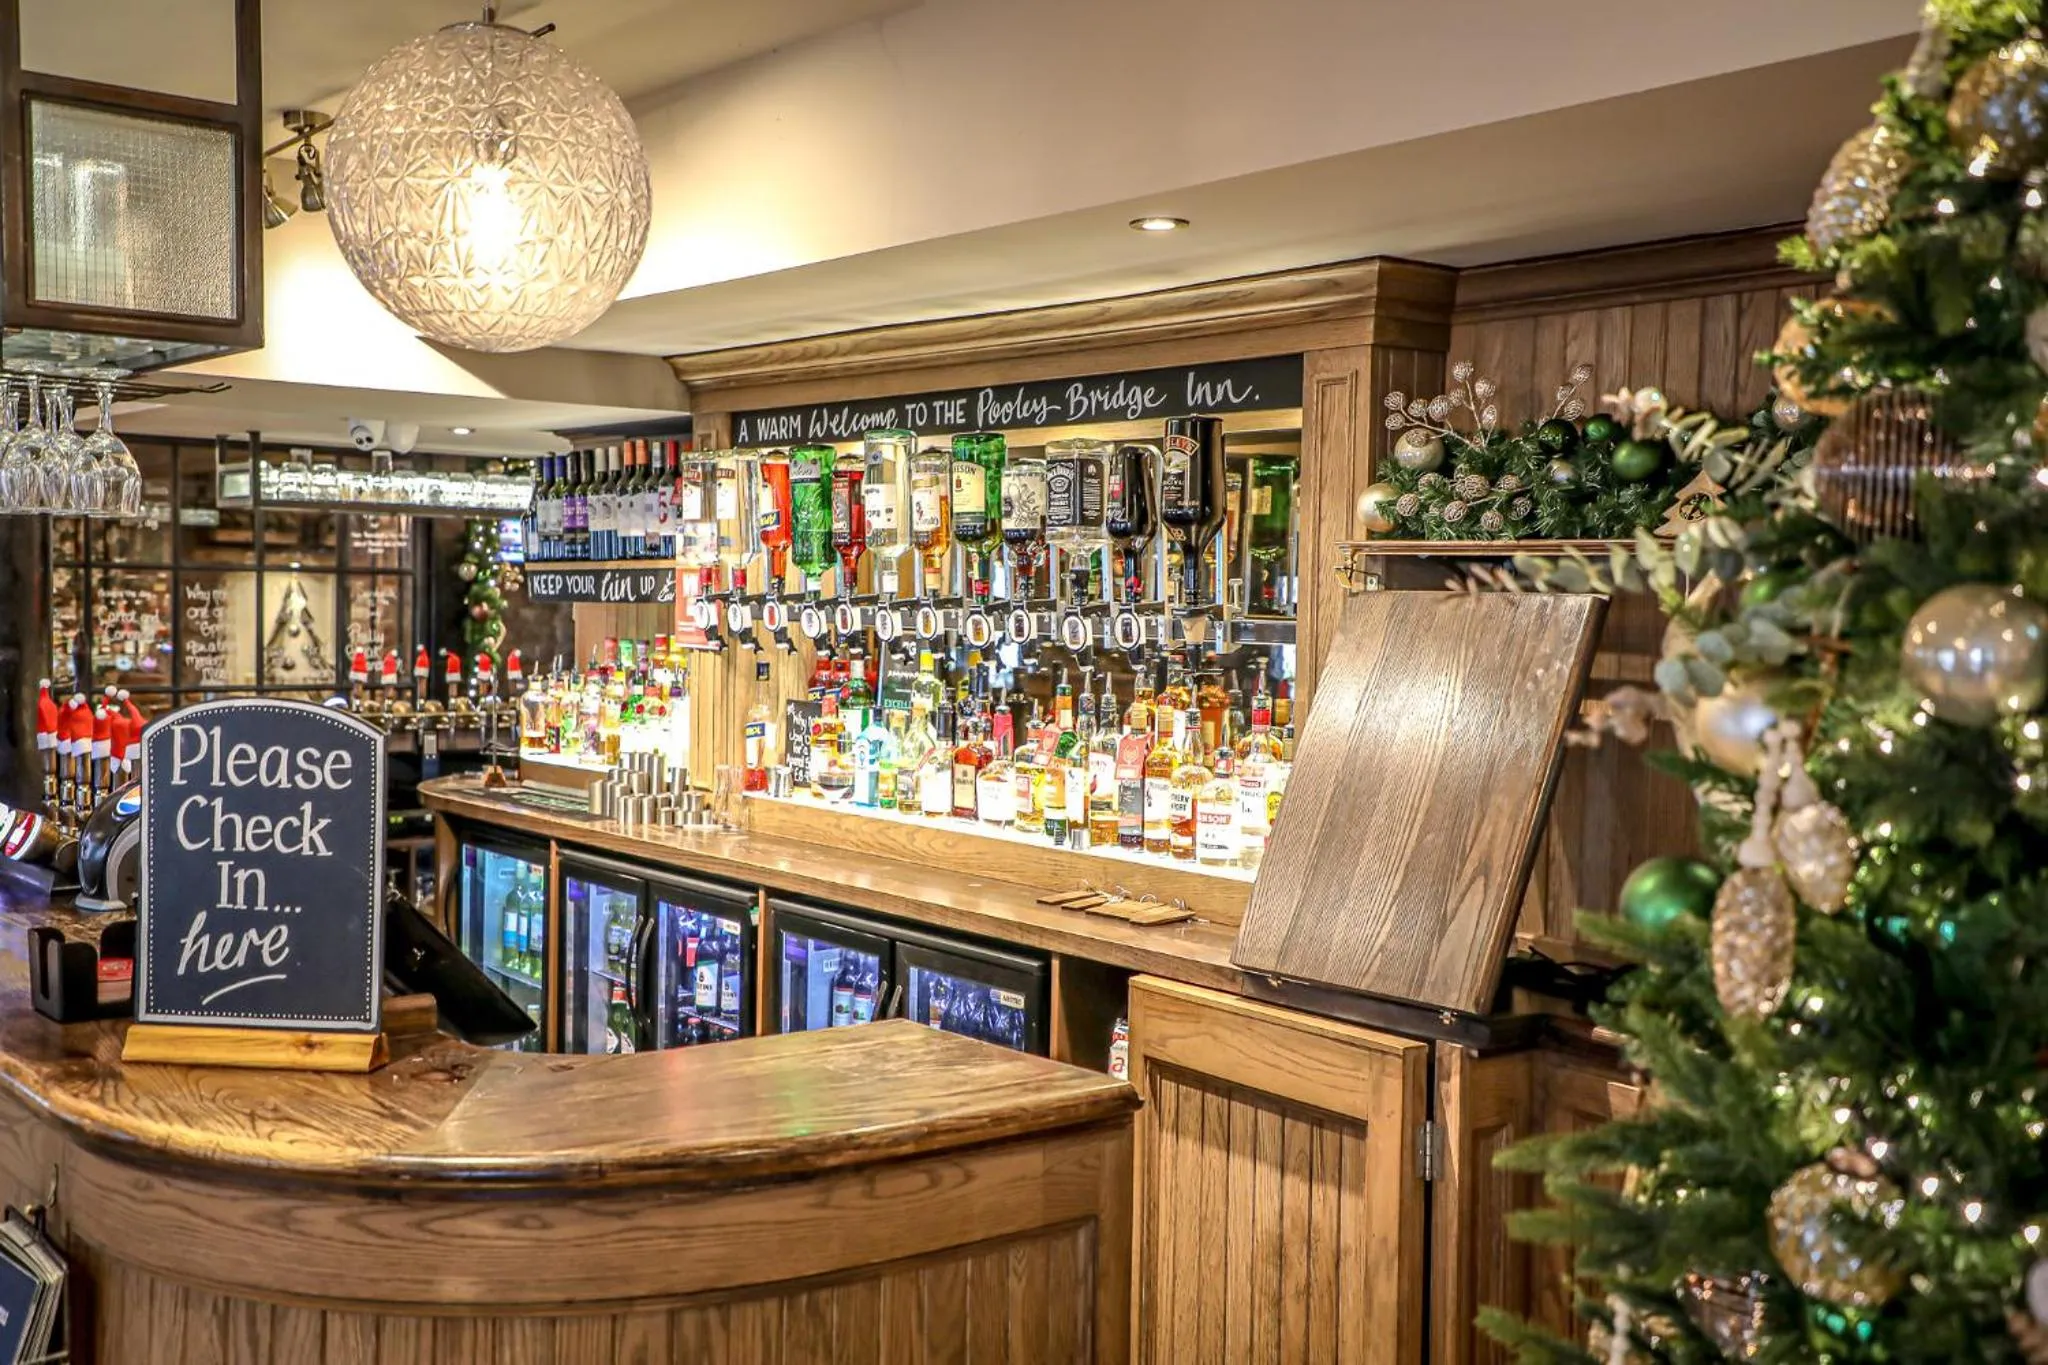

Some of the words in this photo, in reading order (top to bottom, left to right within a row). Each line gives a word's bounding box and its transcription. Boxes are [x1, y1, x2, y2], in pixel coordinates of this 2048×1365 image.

[737, 419, 749, 443] A
[757, 414, 801, 442] WARM
[807, 406, 898, 439] Welcome
[905, 402, 928, 428] TO
[932, 398, 967, 426] THE
[976, 386, 1061, 429] Pooley
[1065, 378, 1168, 422] Bridge
[1185, 371, 1260, 407] Inn.
[533, 574, 563, 595] KEEP
[565, 575, 596, 595] YOUR
[600, 571, 637, 602] Gin
[639, 575, 656, 595] UP
[169, 723, 353, 790] Please
[176, 794, 333, 856] Check
[216, 860, 302, 914] In...
[177, 909, 290, 977] here
